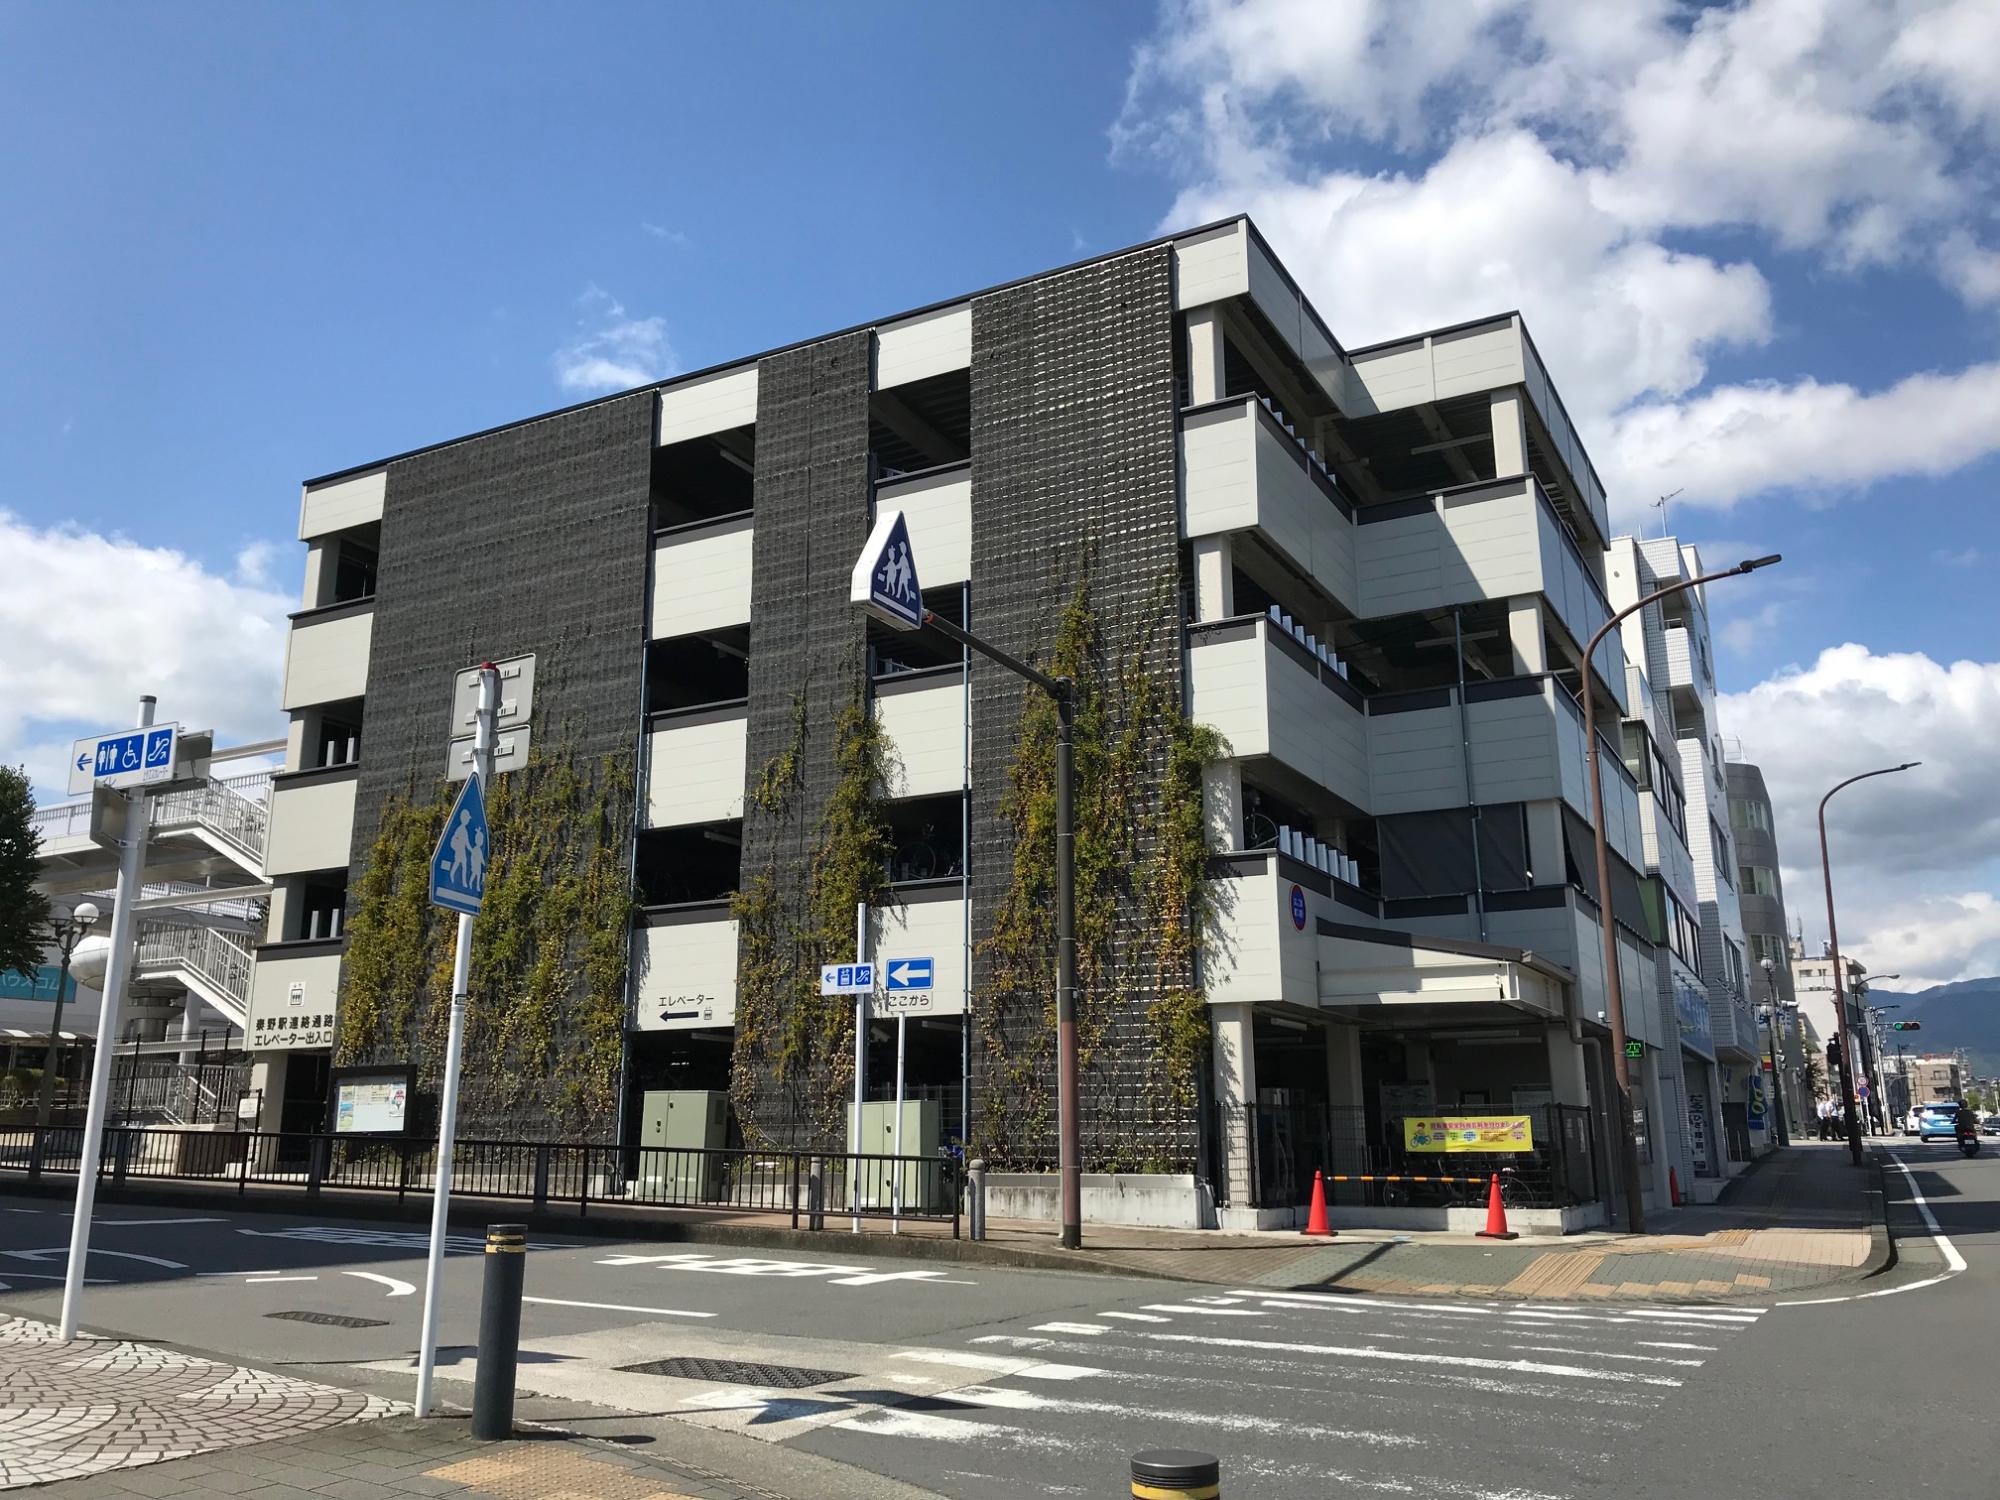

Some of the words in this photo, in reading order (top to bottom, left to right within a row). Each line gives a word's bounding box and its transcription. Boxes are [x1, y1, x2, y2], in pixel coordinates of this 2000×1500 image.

[658, 994, 715, 1007] エレベーター
[888, 994, 930, 1007] ここから
[254, 1031, 332, 1046] エレベーター出入口
